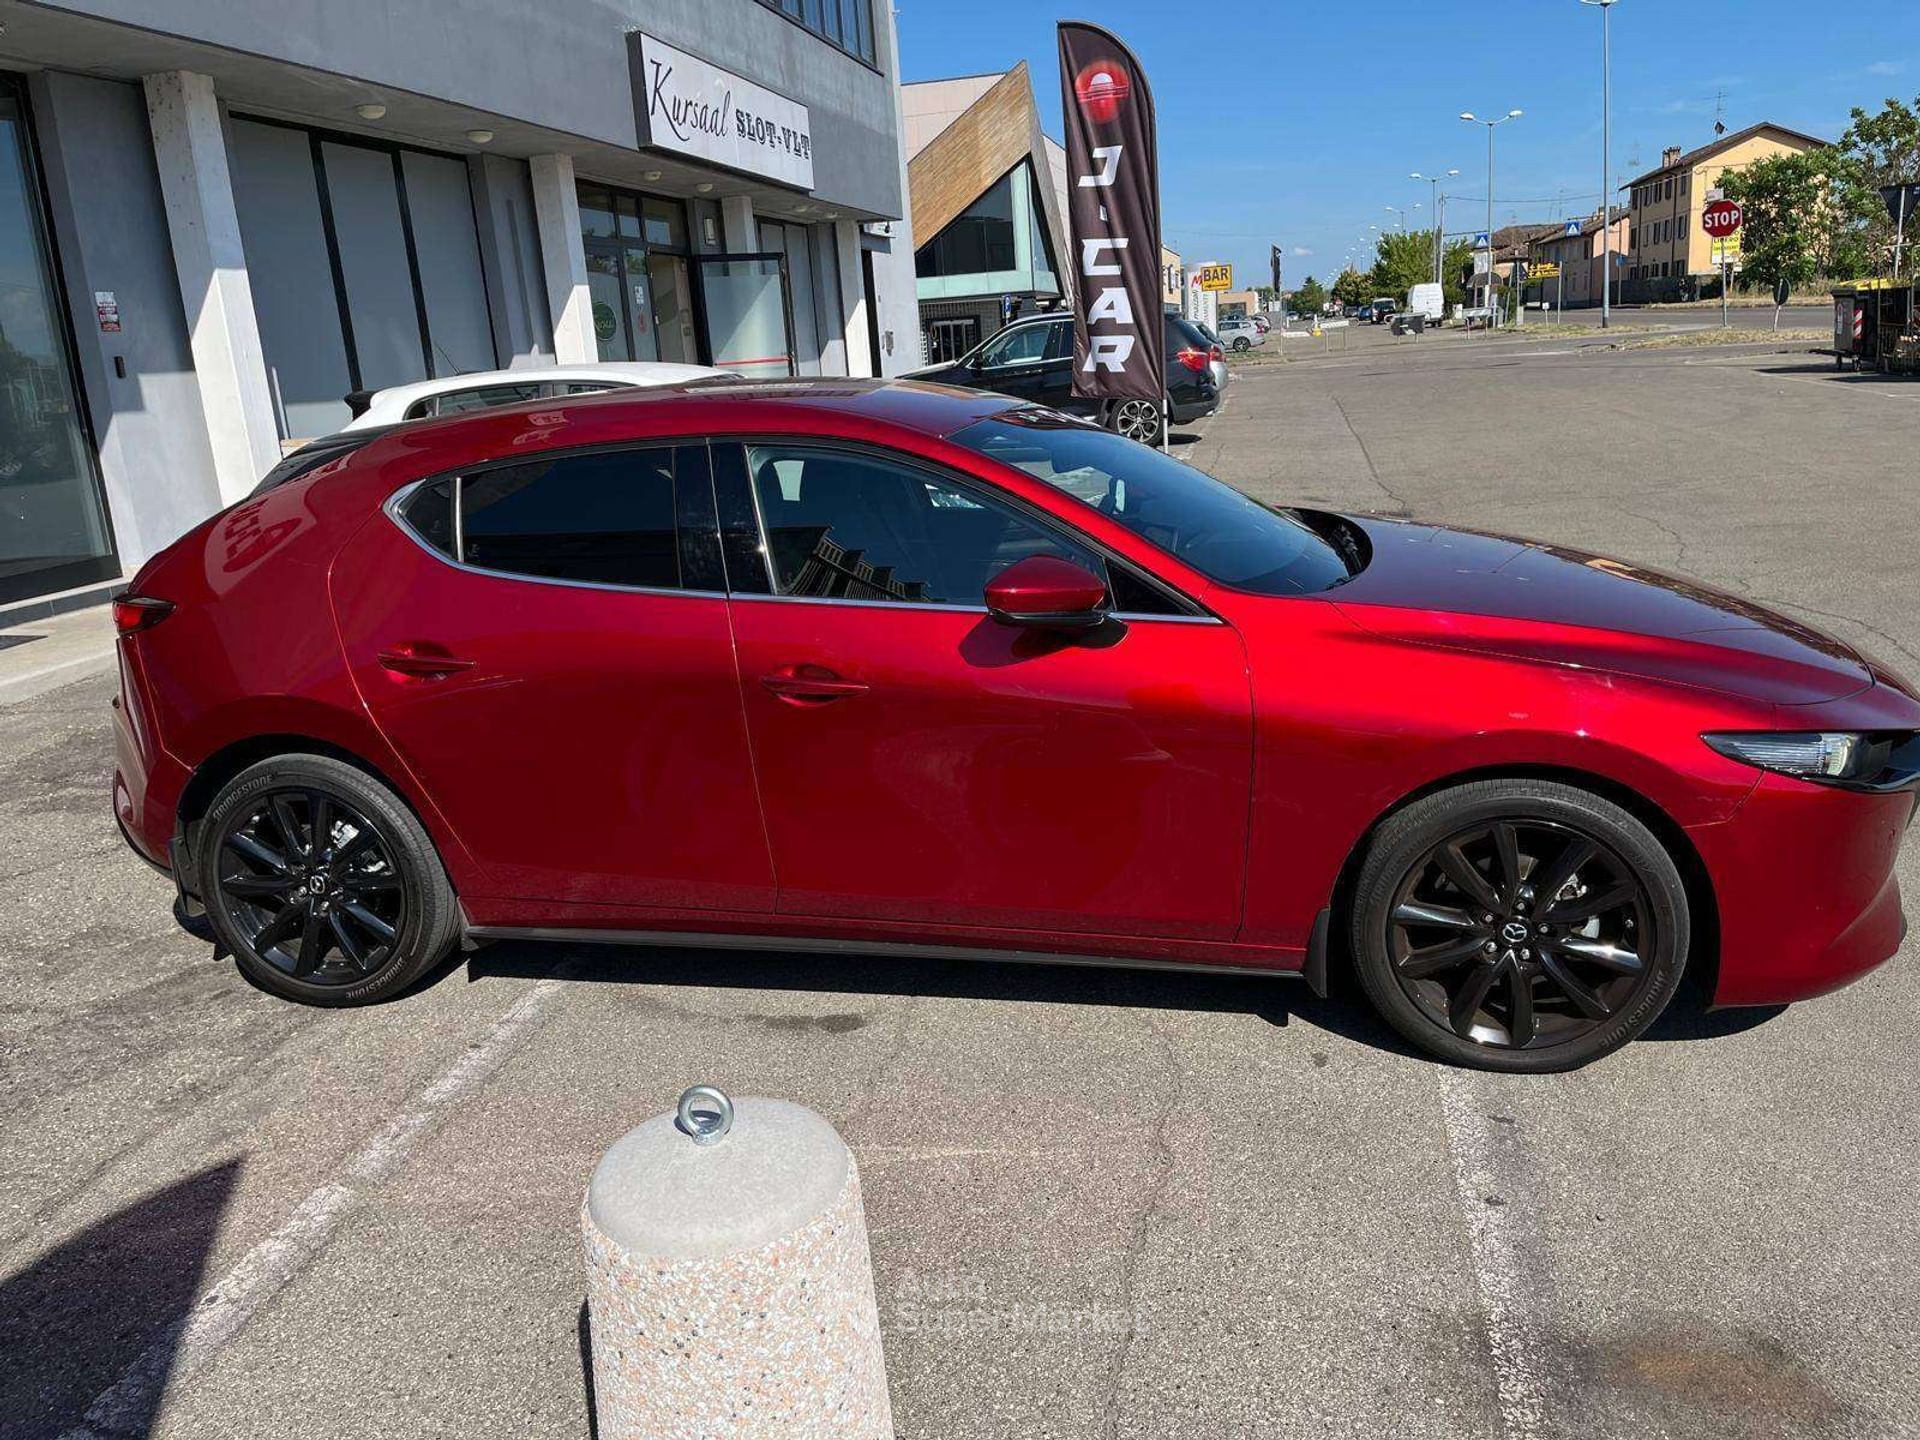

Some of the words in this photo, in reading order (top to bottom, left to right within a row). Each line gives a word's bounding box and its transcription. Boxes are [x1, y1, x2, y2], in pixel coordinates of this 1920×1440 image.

[650, 58, 731, 142] Kursaal
[735, 108, 810, 160] SLOT-VLT
[1704, 209, 1739, 228] STOP
[1203, 268, 1229, 282] BAR
[211, 773, 274, 823] BRIDGESTONE
[345, 956, 405, 999] BRIDGESTONE
[1600, 969, 1667, 1047] BRIDGESTONE
